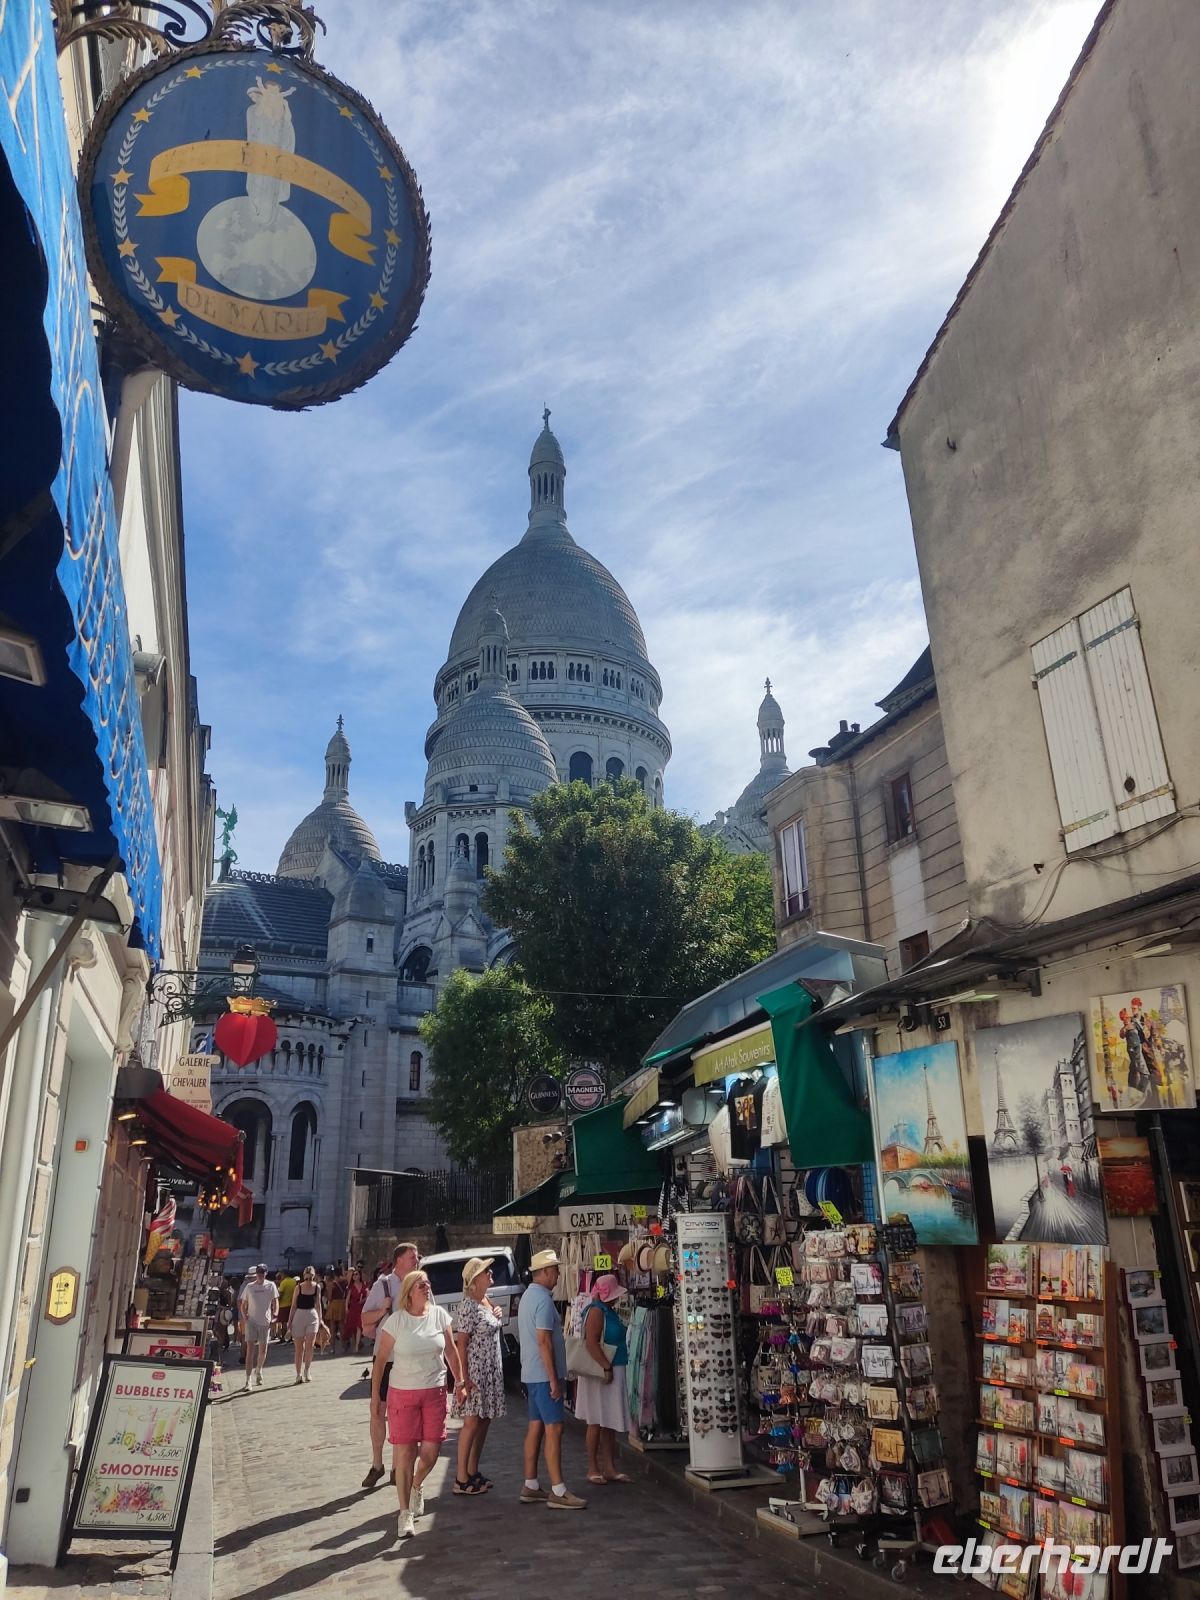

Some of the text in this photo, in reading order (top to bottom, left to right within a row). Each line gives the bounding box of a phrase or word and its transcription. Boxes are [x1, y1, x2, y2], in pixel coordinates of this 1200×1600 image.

[184, 287, 216, 319] DE
[739, 1041, 770, 1065] Souvenirs
[179, 1056, 211, 1067] GALERIE
[172, 1077, 207, 1088] CHEVALIER
[530, 1090, 558, 1100] GUINNESS
[567, 1086, 603, 1094] MAGNERS
[570, 1212, 605, 1228] CAFE
[115, 1384, 194, 1399] BUBBLES TEA
[99, 1463, 179, 1477] SMOOTHIES
